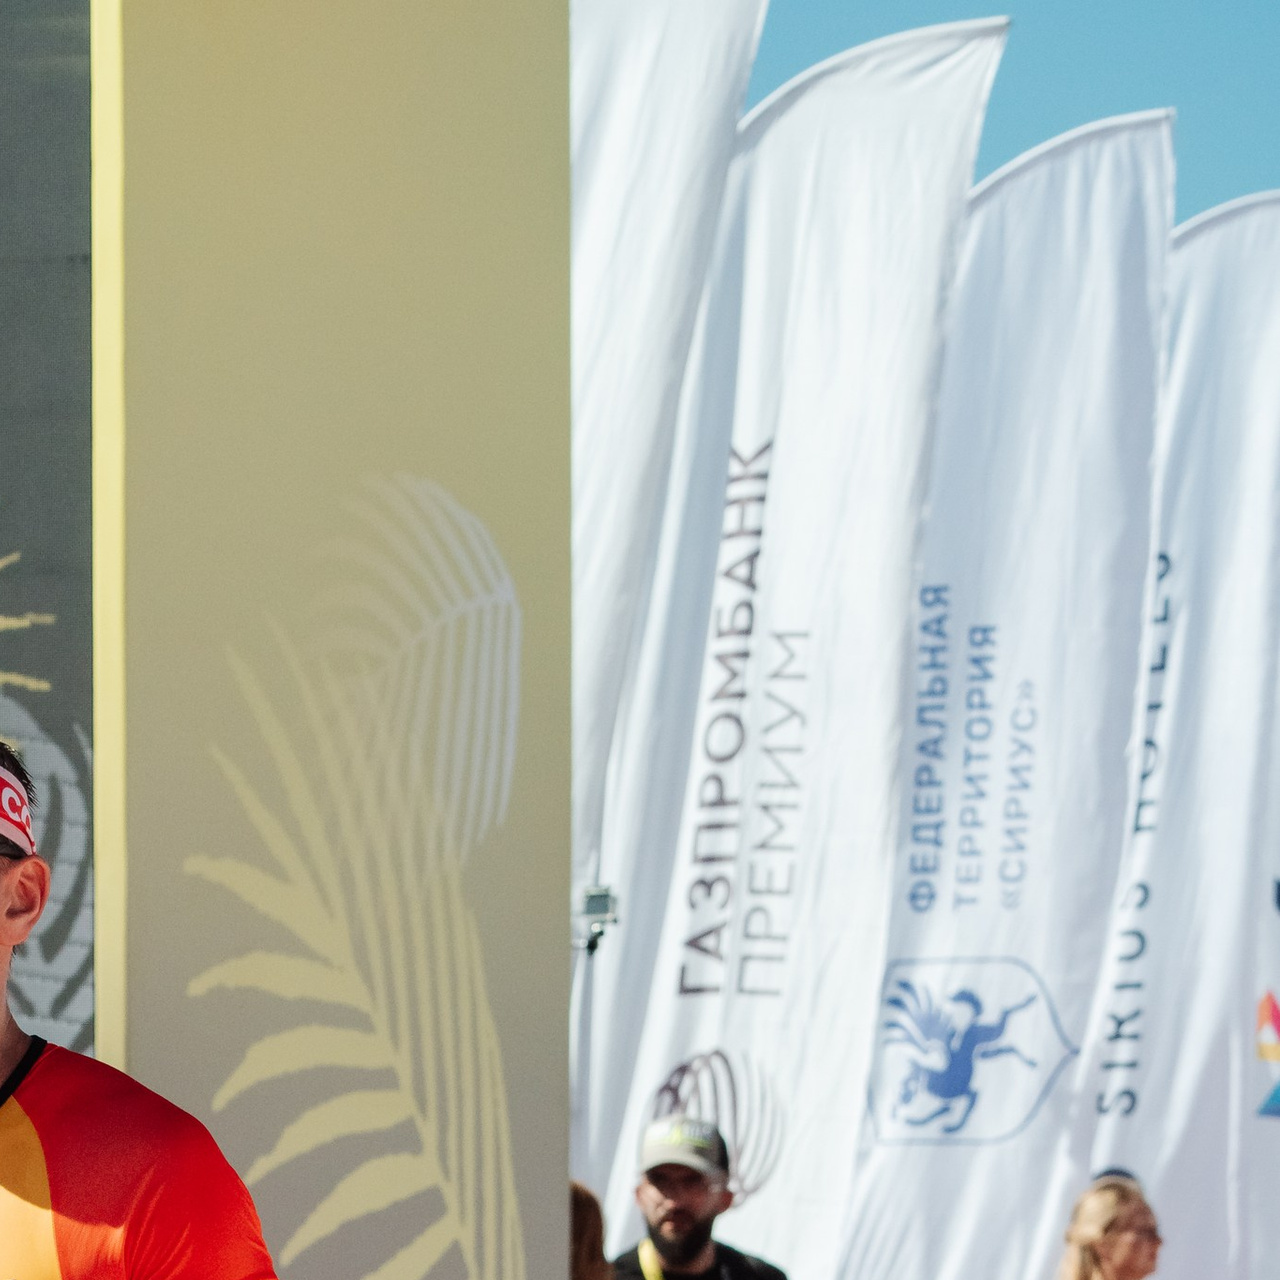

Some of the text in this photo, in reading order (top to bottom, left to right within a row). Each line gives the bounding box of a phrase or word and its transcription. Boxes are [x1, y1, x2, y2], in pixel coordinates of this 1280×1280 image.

[678, 438, 774, 998] ГАЗПРОМБАНК
[736, 629, 813, 998] ПРЕМИУМ
[907, 584, 952, 915] ФЕДЕРАЛЬНАЯ
[952, 623, 999, 911] ТЕРРИТОРИЯ
